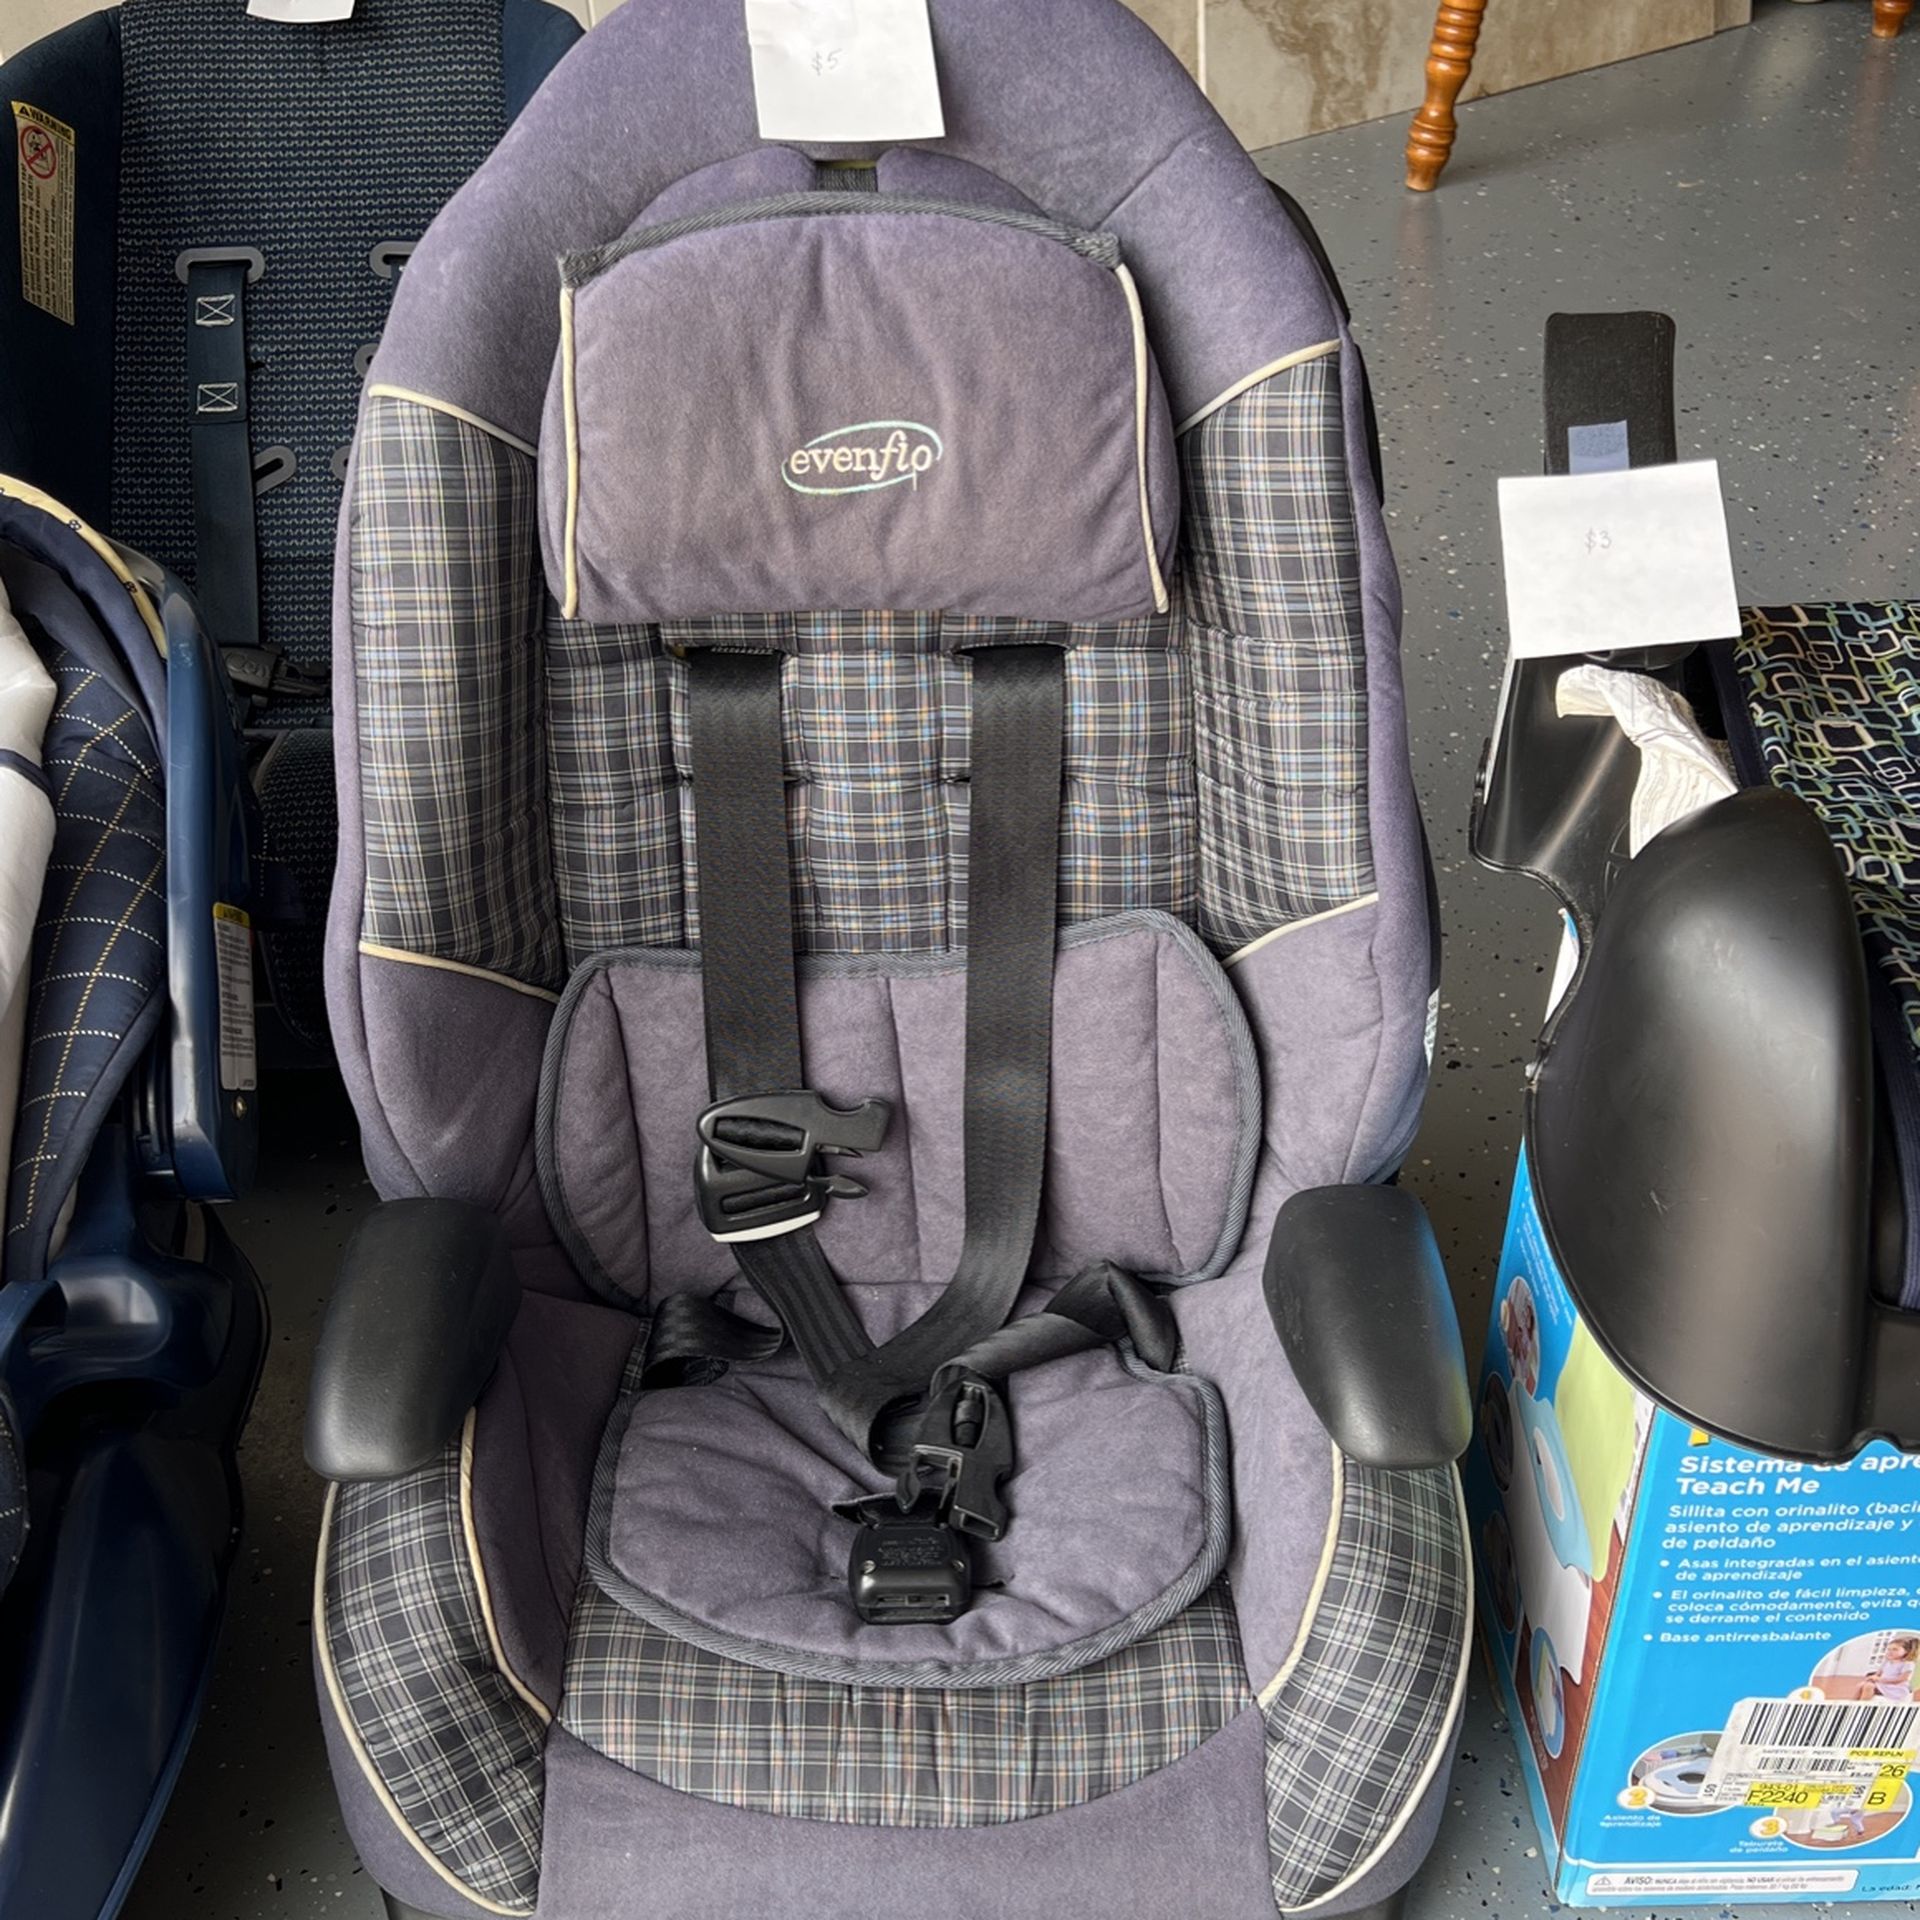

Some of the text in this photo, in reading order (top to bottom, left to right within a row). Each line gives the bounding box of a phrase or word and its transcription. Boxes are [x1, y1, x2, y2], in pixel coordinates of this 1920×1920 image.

[810, 48, 843, 76] $5
[1585, 528, 1612, 554] $3
[1679, 1456, 1802, 1473] Sistema
[1676, 1477, 1820, 1495] Teach Me
[1669, 1504, 1726, 1518] Sillita
[1731, 1507, 1769, 1518] con
[1775, 1503, 1860, 1517] orinalito
[1664, 1517, 1913, 1535] asiento de aprendizaje y
[1661, 1536, 1777, 1551] de peldaño
[1678, 1558, 1719, 1569] Asas
[1724, 1557, 1815, 1570] integradas
[1820, 1556, 1841, 1567] en
[1846, 1555, 1863, 1566] el
[1675, 1569, 1803, 1582] de aprendizaje
[1671, 1590, 1688, 1600] El
[1692, 1589, 1763, 1600] orinalito
[1768, 1589, 1790, 1599] de
[1795, 1587, 1832, 1599] fácil
[1667, 1601, 1724, 1612] coloca
[1861, 1598, 1902, 1609] evita
[1665, 1610, 1870, 1624] se derrame el contenido
[1659, 1630, 1831, 1643] Base antirresbalante
[1879, 1764, 1906, 1778] 26
[1628, 1788, 1648, 1806] 2
[1747, 1790, 1808, 1804] F2240
[1867, 1792, 1886, 1804] B
[1760, 1819, 1780, 1836] 3
